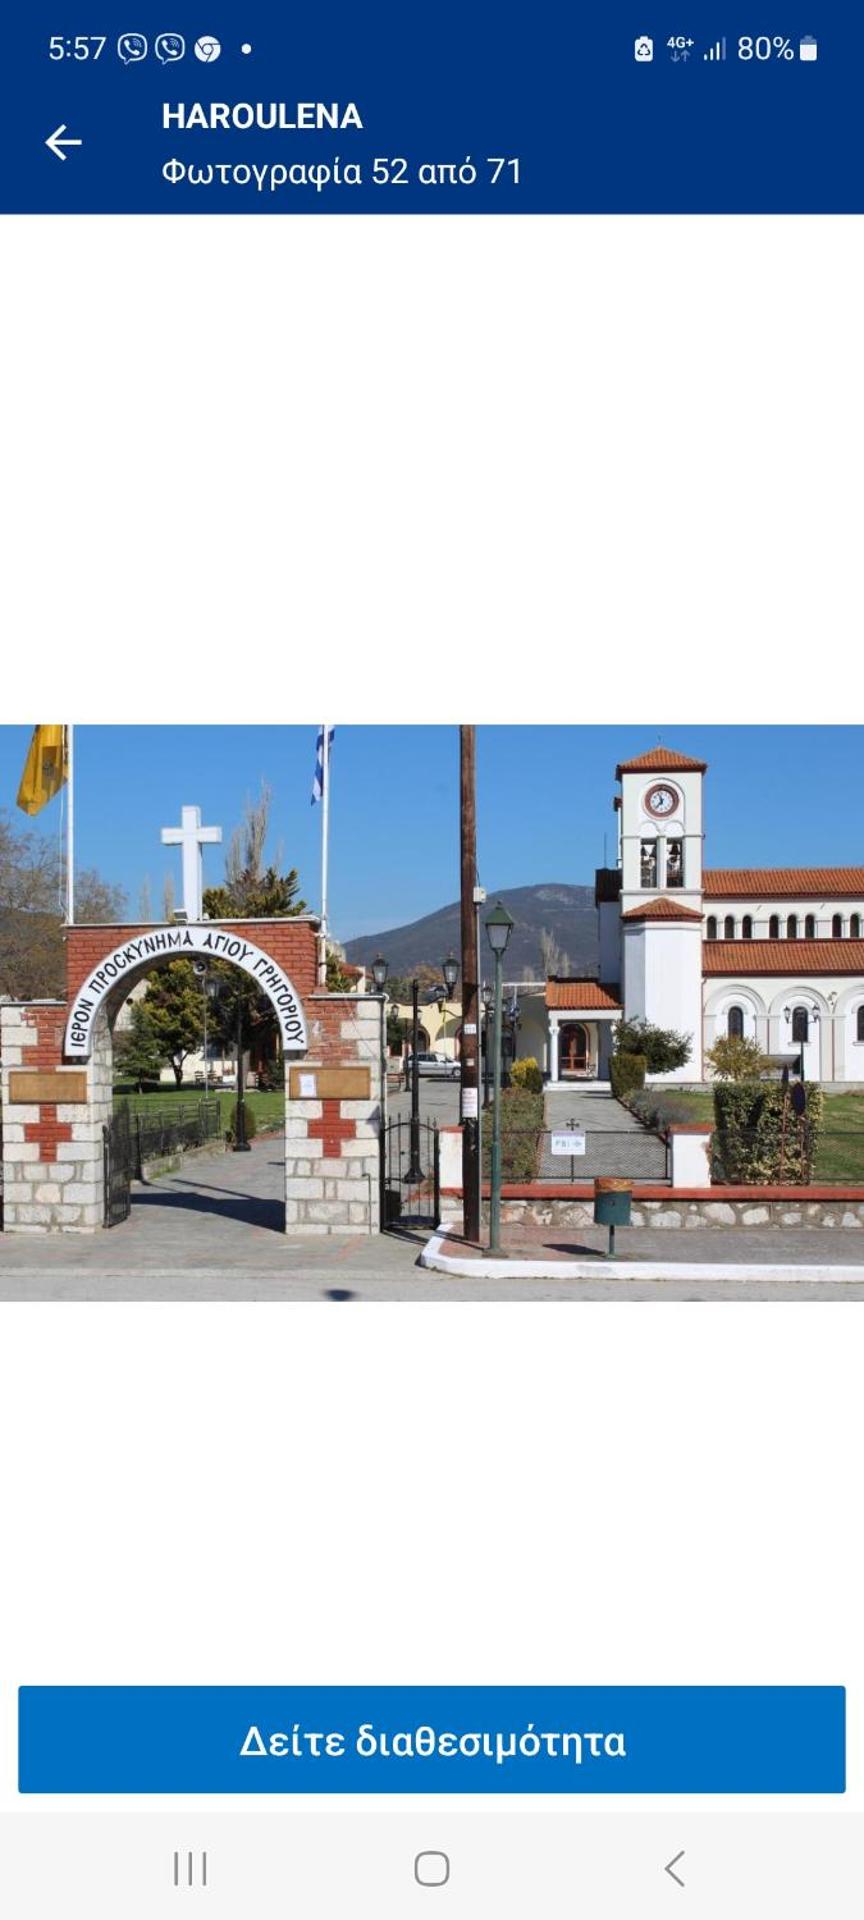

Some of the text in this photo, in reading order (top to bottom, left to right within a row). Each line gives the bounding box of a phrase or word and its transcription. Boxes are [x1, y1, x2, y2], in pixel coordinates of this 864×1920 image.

[49, 36, 107, 61] 5:57
[666, 36, 695, 49] 4G+
[737, 36, 795, 61] 80%
[162, 102, 364, 130] HAROULENA
[161, 155, 520, 193] Φωτογραφία 52 από 71
[203, 933, 254, 962] ΑΓΙΟΥ
[253, 958, 304, 1043] ΓΡΗΓΟΡΙΟΥ
[239, 1723, 627, 1765] Δείτε διαθεσιμότητα
